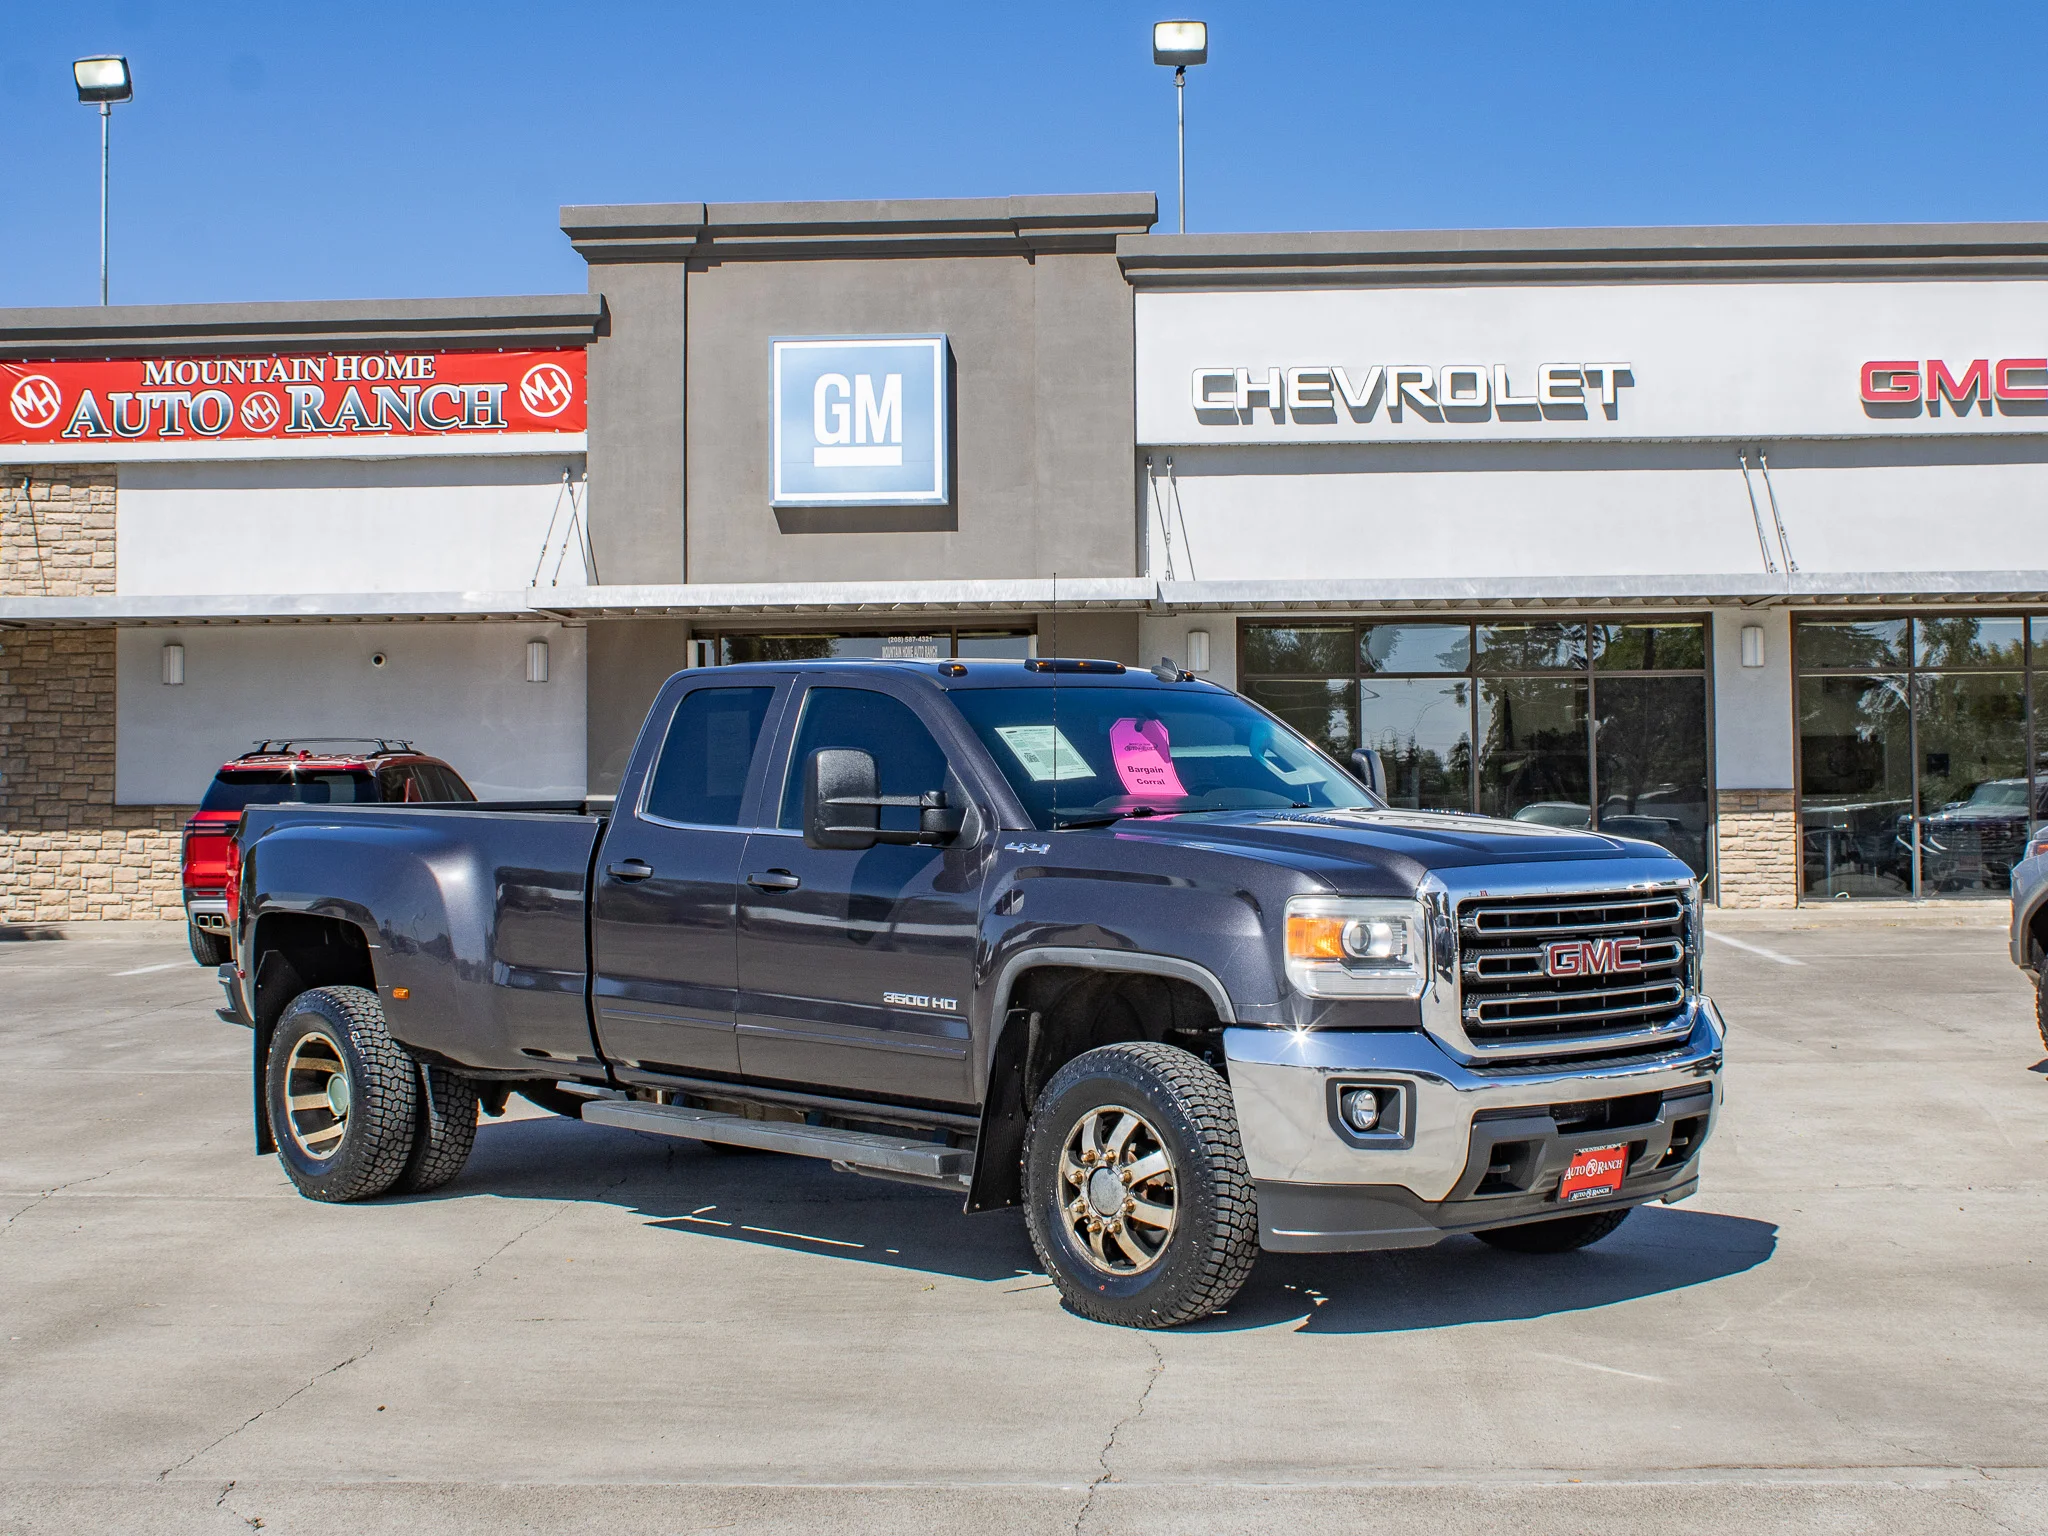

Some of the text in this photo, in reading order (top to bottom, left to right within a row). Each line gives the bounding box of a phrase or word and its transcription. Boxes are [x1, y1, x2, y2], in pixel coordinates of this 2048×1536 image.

[142, 354, 436, 385] MOUNTAIN HOME
[1191, 362, 1632, 410] CHEVROLET
[1860, 358, 2048, 403] GMC
[61, 388, 234, 438] AUTO
[284, 382, 508, 433] RANCH
[814, 373, 902, 445] GM
[1127, 765, 1164, 775] Bargain
[1136, 778, 1166, 786] Corral
[1546, 936, 1641, 977] GMC
[883, 991, 958, 1011] 3500 HD
[1563, 1165, 1586, 1181] AUTO
[1596, 1159, 1623, 1175] RANCH
